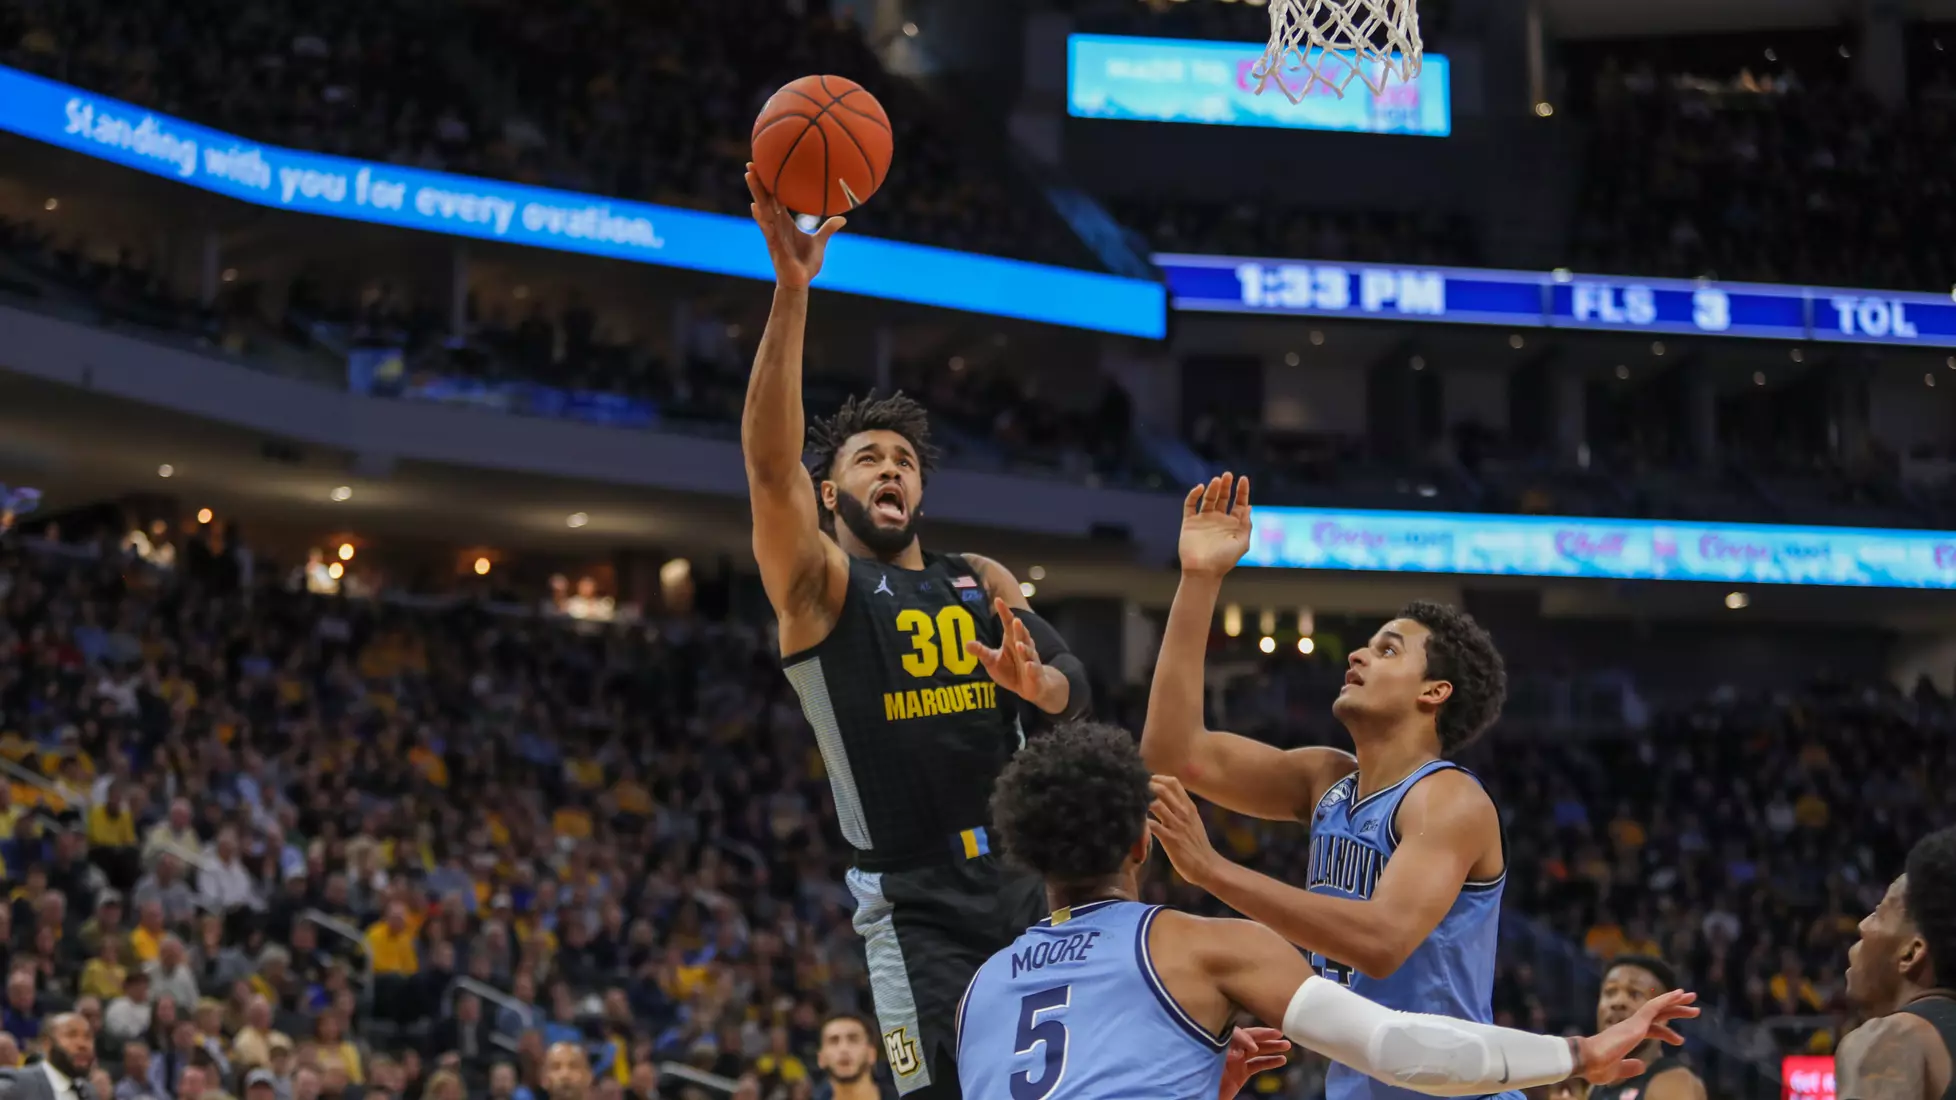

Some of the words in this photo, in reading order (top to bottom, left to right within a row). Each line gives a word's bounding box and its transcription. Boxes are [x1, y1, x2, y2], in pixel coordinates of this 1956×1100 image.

[65, 97, 197, 177] Standing
[204, 144, 271, 190] with
[279, 167, 347, 203] you
[355, 167, 406, 211] for
[415, 187, 516, 235] every
[521, 202, 665, 249] ovation.
[1236, 263, 1348, 309] 1:33
[1360, 268, 1445, 315] PM
[1572, 282, 1655, 325] FLS
[1692, 287, 1731, 331] 3
[1829, 295, 1917, 338] TOL
[896, 605, 978, 677] 30
[1012, 932, 1100, 978] MOORE
[1009, 985, 1071, 1100] 5
